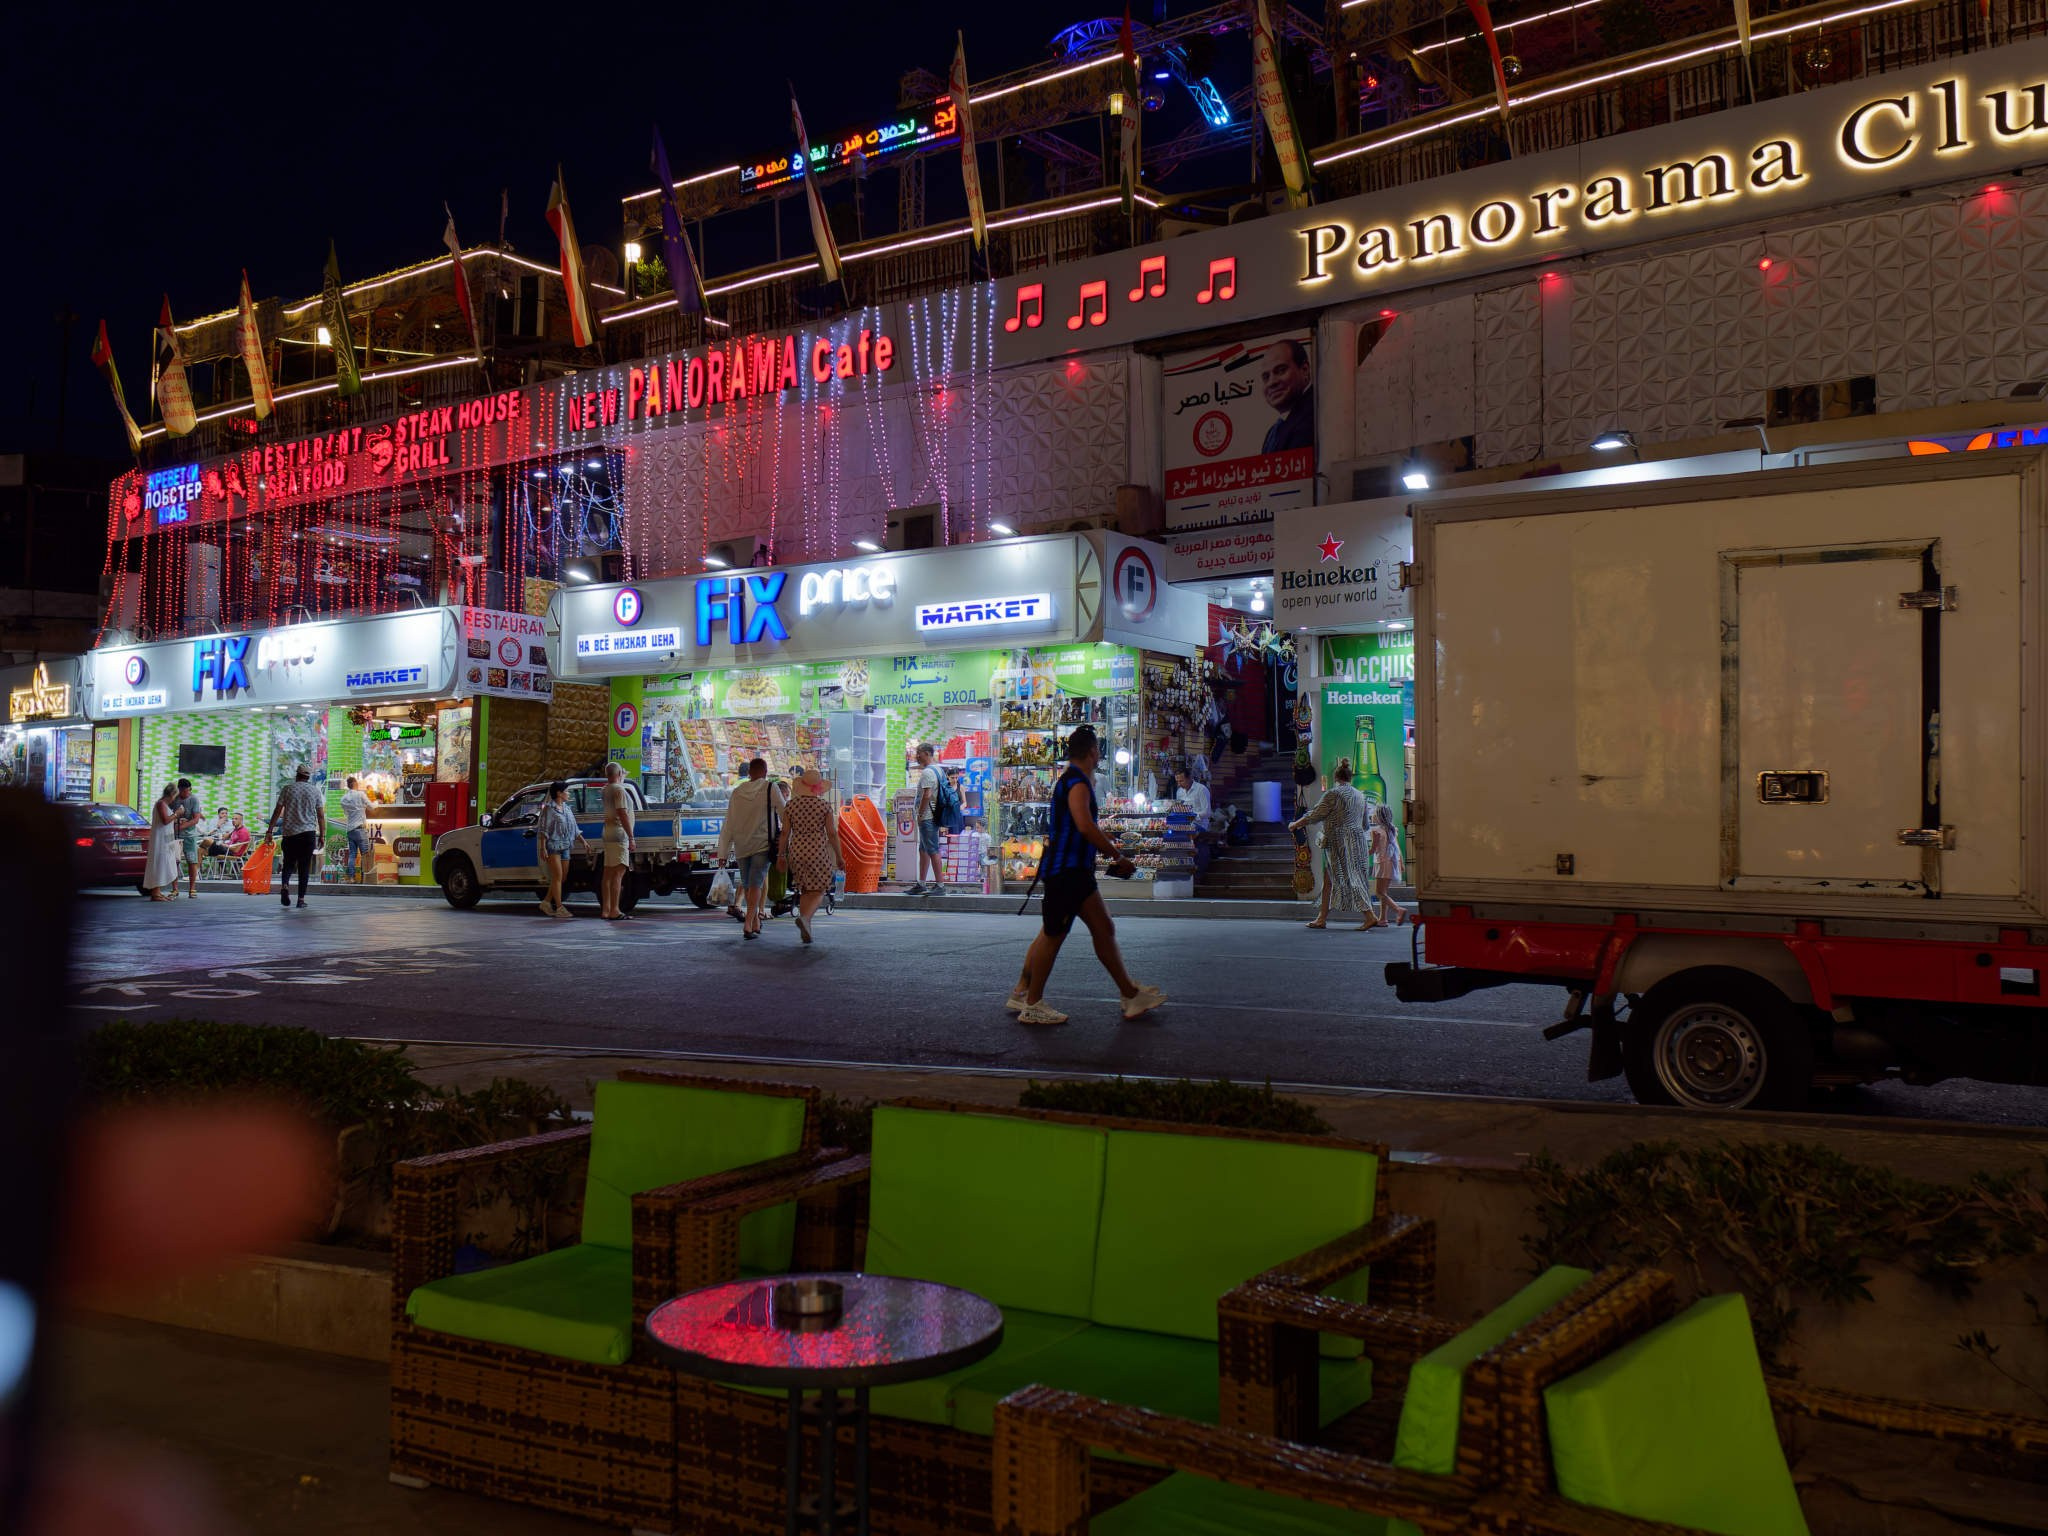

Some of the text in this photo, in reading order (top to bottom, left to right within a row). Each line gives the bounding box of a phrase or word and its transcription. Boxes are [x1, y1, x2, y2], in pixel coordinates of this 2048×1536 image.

[1299, 79, 2048, 283] Panorama Clu
[569, 330, 894, 432] NEW PANORAMA Cafe
[1173, 380, 1256, 415] تحيا مصر
[397, 391, 521, 443] STEAK HOUSE
[400, 439, 450, 473] GRILL
[269, 461, 346, 501] SEA FOOD
[1172, 455, 1307, 496] إدارة نيو بانوراما شرم
[144, 482, 202, 509] ЛОБСТЕР
[1174, 533, 1275, 556] مهورية مصر العربية
[1197, 557, 1226, 570] جديدة
[799, 564, 895, 615] price
[1127, 564, 1145, 604] F
[1281, 566, 1377, 590] Heineken
[622, 597, 633, 618] F
[1282, 587, 1378, 610] open your world
[463, 611, 545, 637] RESTAURAN
[921, 598, 1041, 626] MARKET
[578, 633, 675, 653] НА ВСЁ НИЗКАЯ ЦЕНА
[346, 667, 422, 687] MARKET
[873, 692, 925, 706] ENTRANCE
[943, 689, 977, 705] ВХОД
[1327, 691, 1401, 705] Heineken
[620, 710, 631, 729] F
[398, 841, 420, 853] Corner
